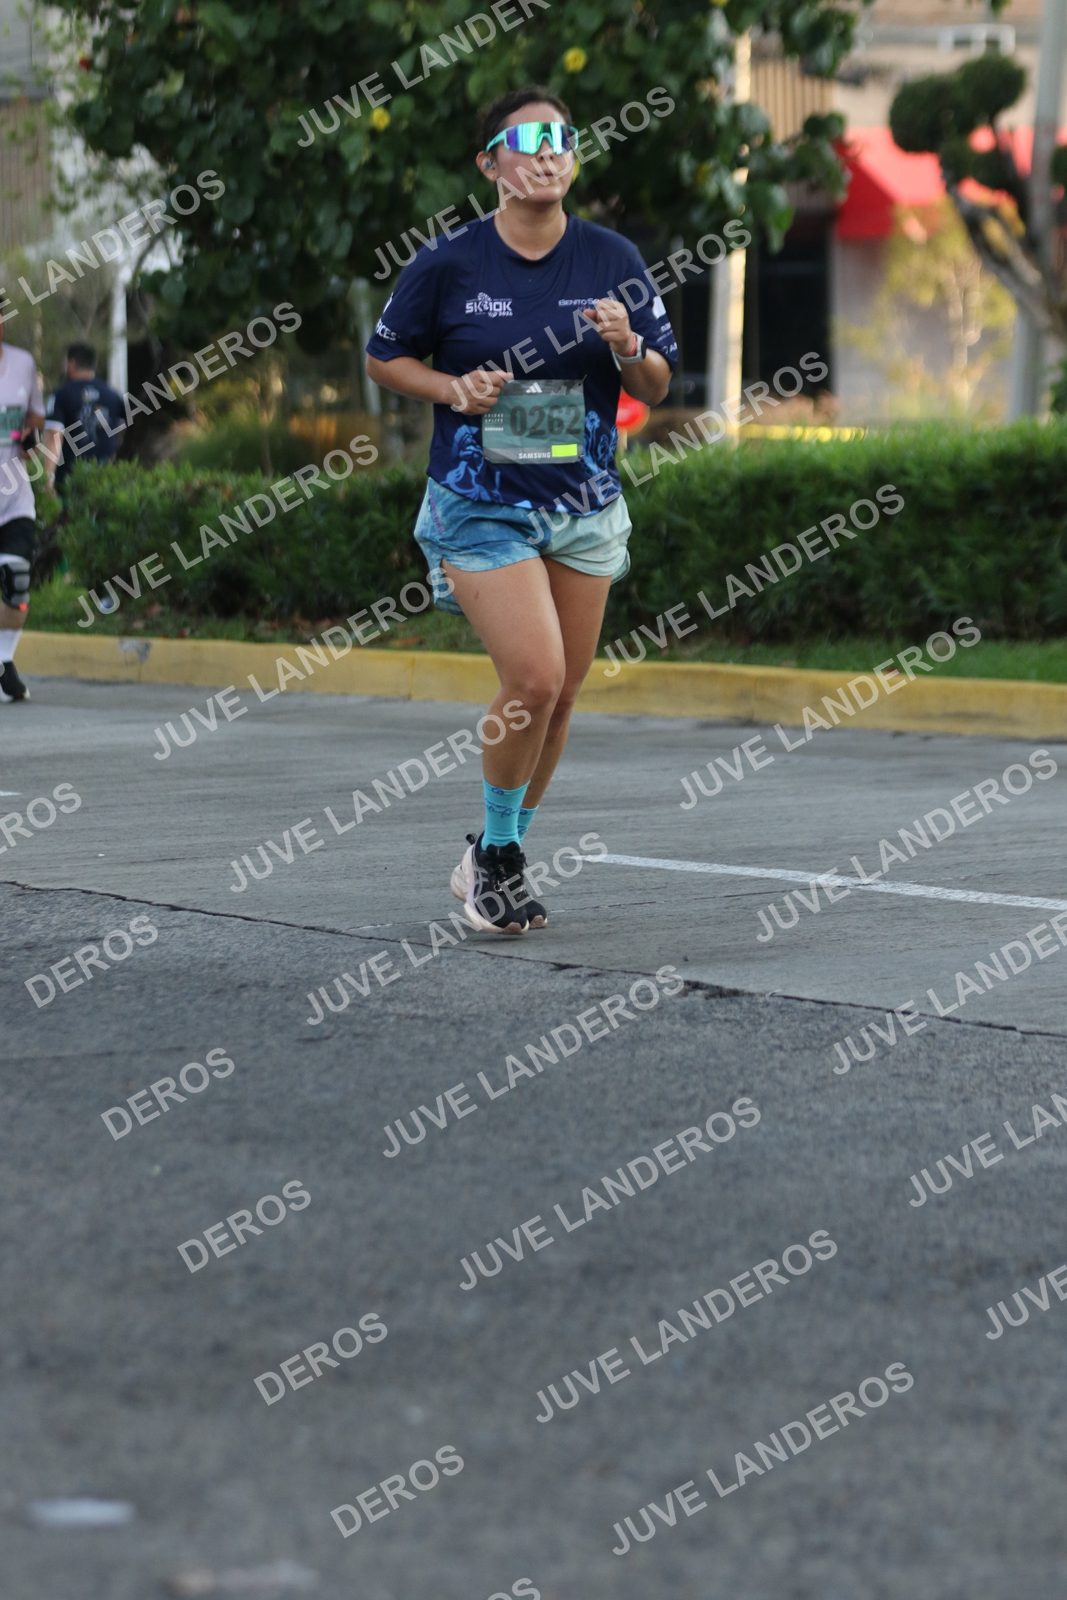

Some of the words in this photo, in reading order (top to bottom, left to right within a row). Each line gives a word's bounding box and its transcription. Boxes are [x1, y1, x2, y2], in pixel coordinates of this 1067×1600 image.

[465, 302, 483, 314] 5K
[489, 301, 513, 312] 10K
[510, 404, 582, 437] 0262
